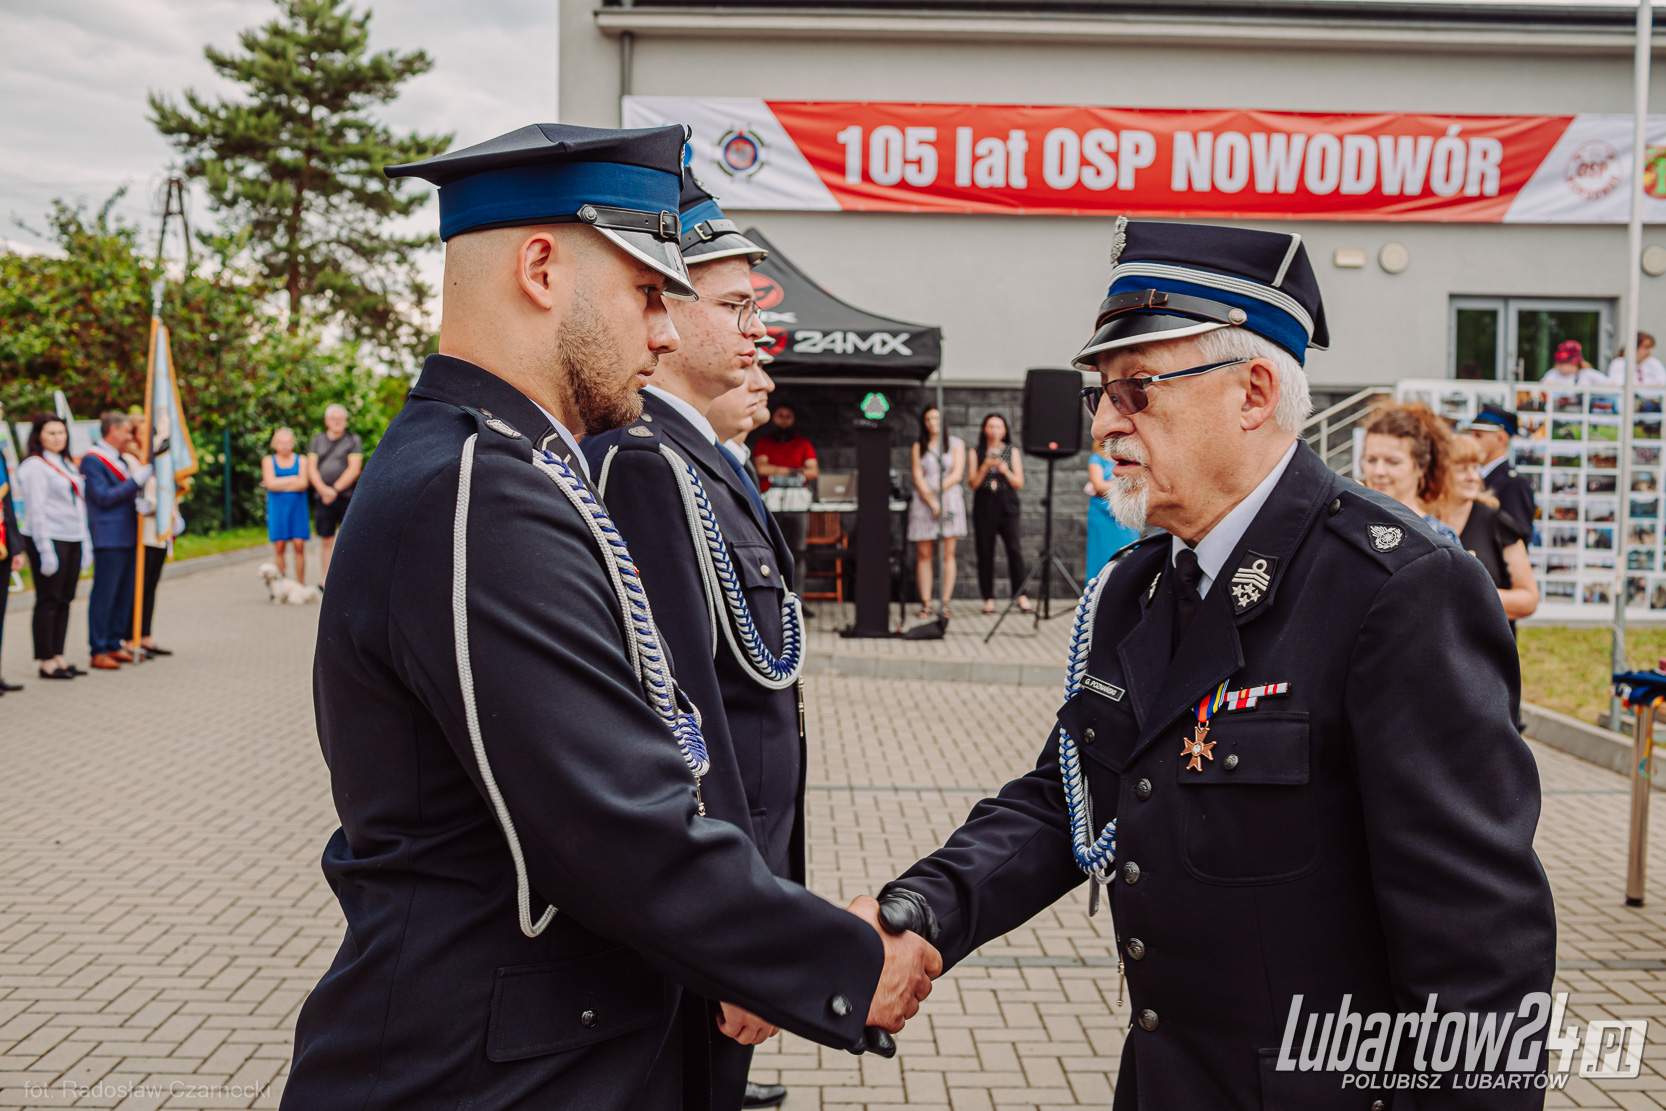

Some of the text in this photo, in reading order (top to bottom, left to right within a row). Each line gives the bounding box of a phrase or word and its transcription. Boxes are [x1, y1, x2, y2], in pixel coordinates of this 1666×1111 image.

[837, 124, 1504, 197] 105 lat OSP NOWODWÓR
[793, 330, 913, 356] 24MX
